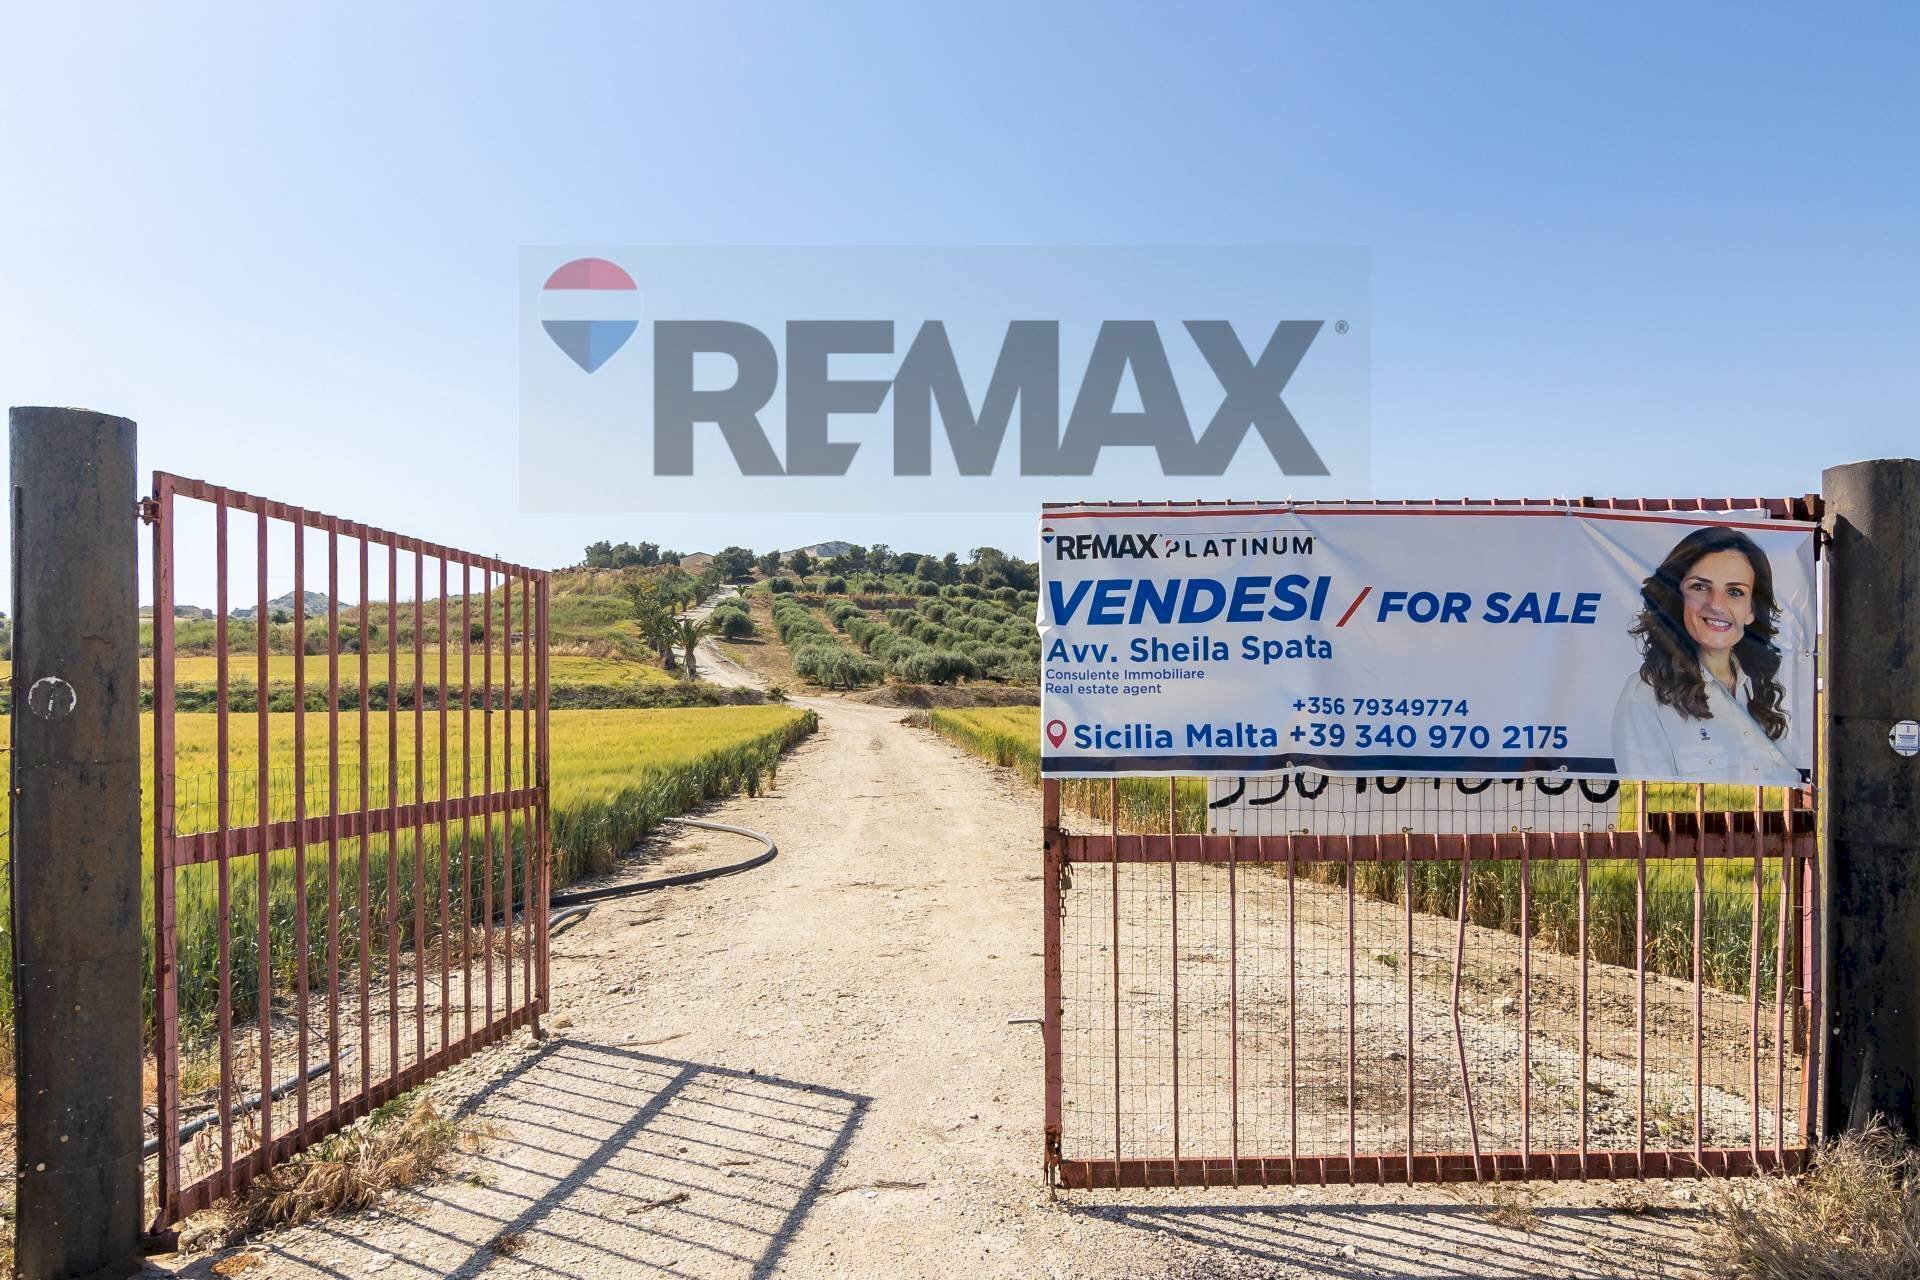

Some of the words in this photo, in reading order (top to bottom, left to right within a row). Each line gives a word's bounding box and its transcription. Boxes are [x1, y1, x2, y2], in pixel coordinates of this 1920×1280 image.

[1166, 536, 1314, 559] PLATINUM
[1048, 574, 1332, 626] VENDESI
[1377, 591, 1472, 624] FOR
[1482, 591, 1601, 624] SALE
[1046, 638, 1118, 663] Avv.
[1129, 636, 1229, 662] Sheila
[1241, 634, 1333, 665] Spata
[1045, 669, 1120, 681] Consulente
[1124, 668, 1205, 680] Immobiliare
[1045, 683, 1073, 695] Real
[1077, 684, 1119, 695] estate
[1123, 684, 1162, 697] agent
[1292, 697, 1346, 716] +356
[1352, 698, 1469, 717] 79349774
[1074, 723, 1173, 749] Sicilia
[1186, 722, 1278, 748] Malta
[1289, 723, 1346, 748] +39
[1355, 724, 1417, 749] 340
[1428, 725, 1490, 750] 970
[1502, 725, 1568, 750] 2175
